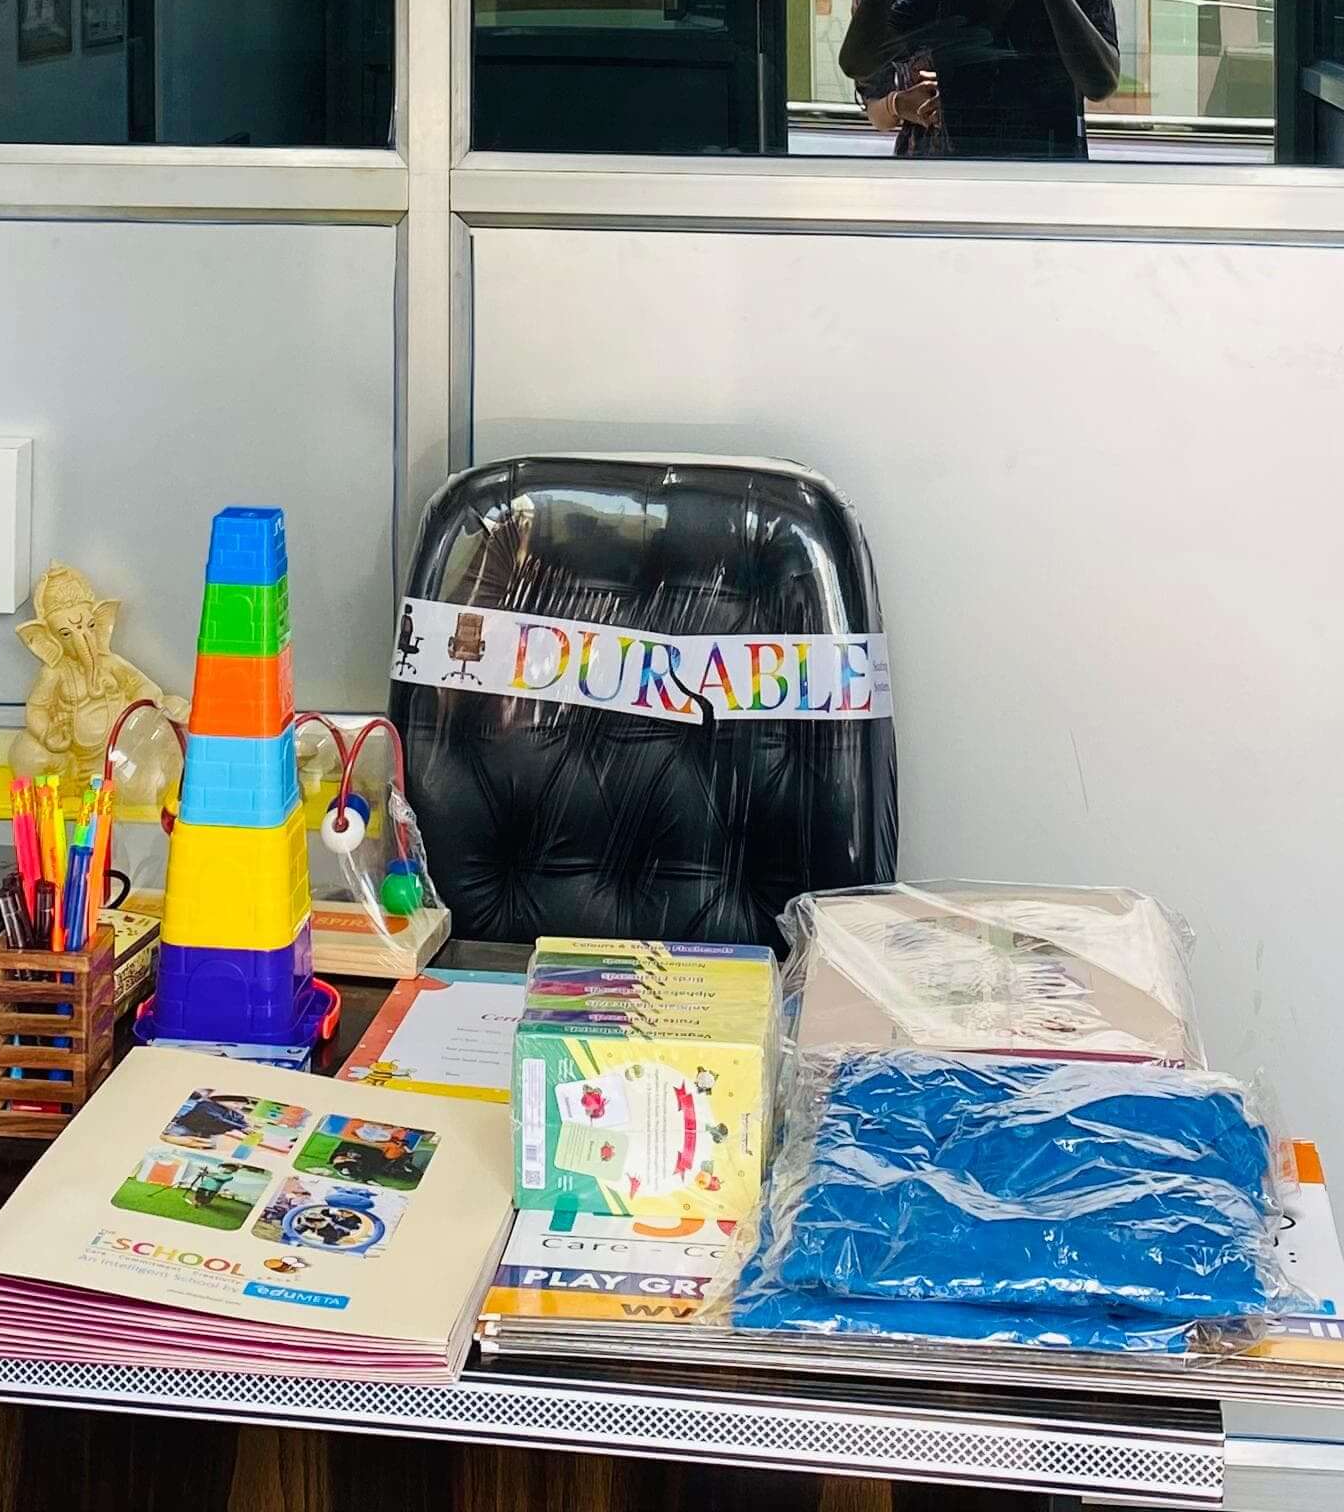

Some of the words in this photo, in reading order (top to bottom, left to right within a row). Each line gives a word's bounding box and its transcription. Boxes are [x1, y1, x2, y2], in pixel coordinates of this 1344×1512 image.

[510, 619, 873, 718] DURABLE
[90, 1229, 246, 1279] i-SCHOOL
[542, 1238, 630, 1253] Care
[522, 1269, 616, 1291] PLAY
[257, 1285, 343, 1308] eduMETA
